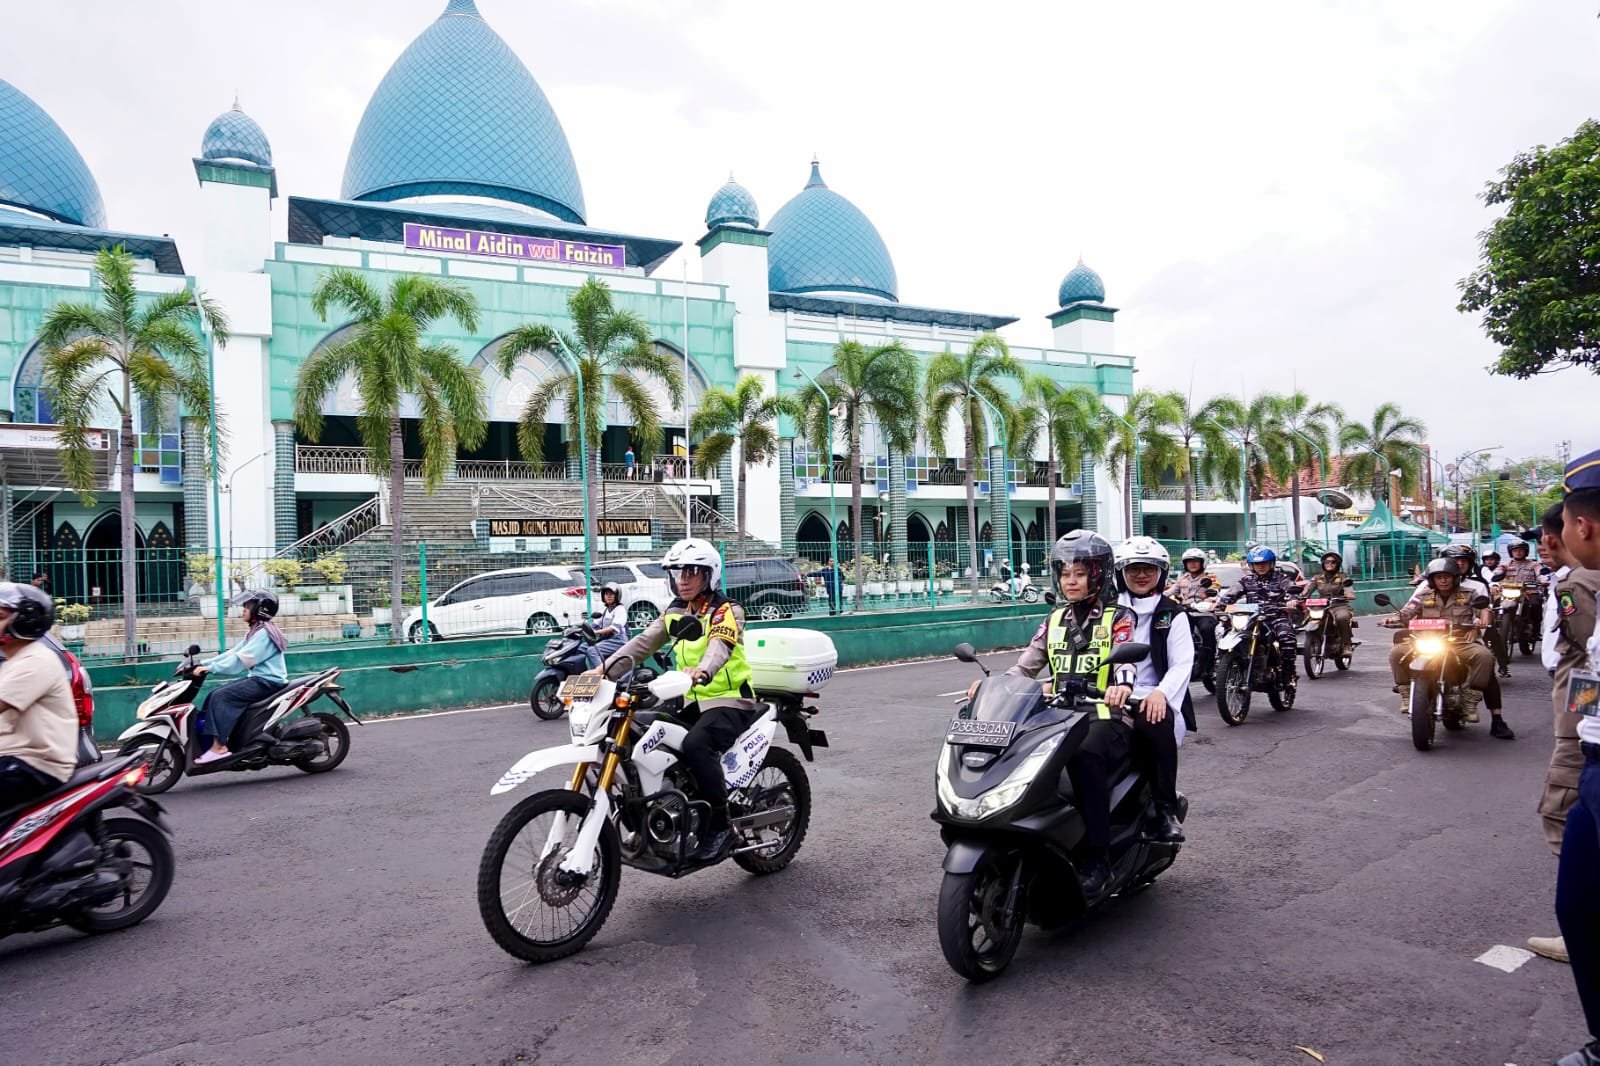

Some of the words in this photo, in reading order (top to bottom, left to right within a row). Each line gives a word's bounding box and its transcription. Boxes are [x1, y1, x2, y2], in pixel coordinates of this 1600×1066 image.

[418, 228, 471, 251] Minal
[477, 234, 524, 256] Aidin
[528, 240, 560, 260] wal
[565, 244, 614, 265] Faizin
[492, 520, 520, 535] MASJID
[522, 520, 547, 535] AGUNG
[606, 519, 649, 534] BANYUWANGI
[642, 726, 666, 754] POLISI
